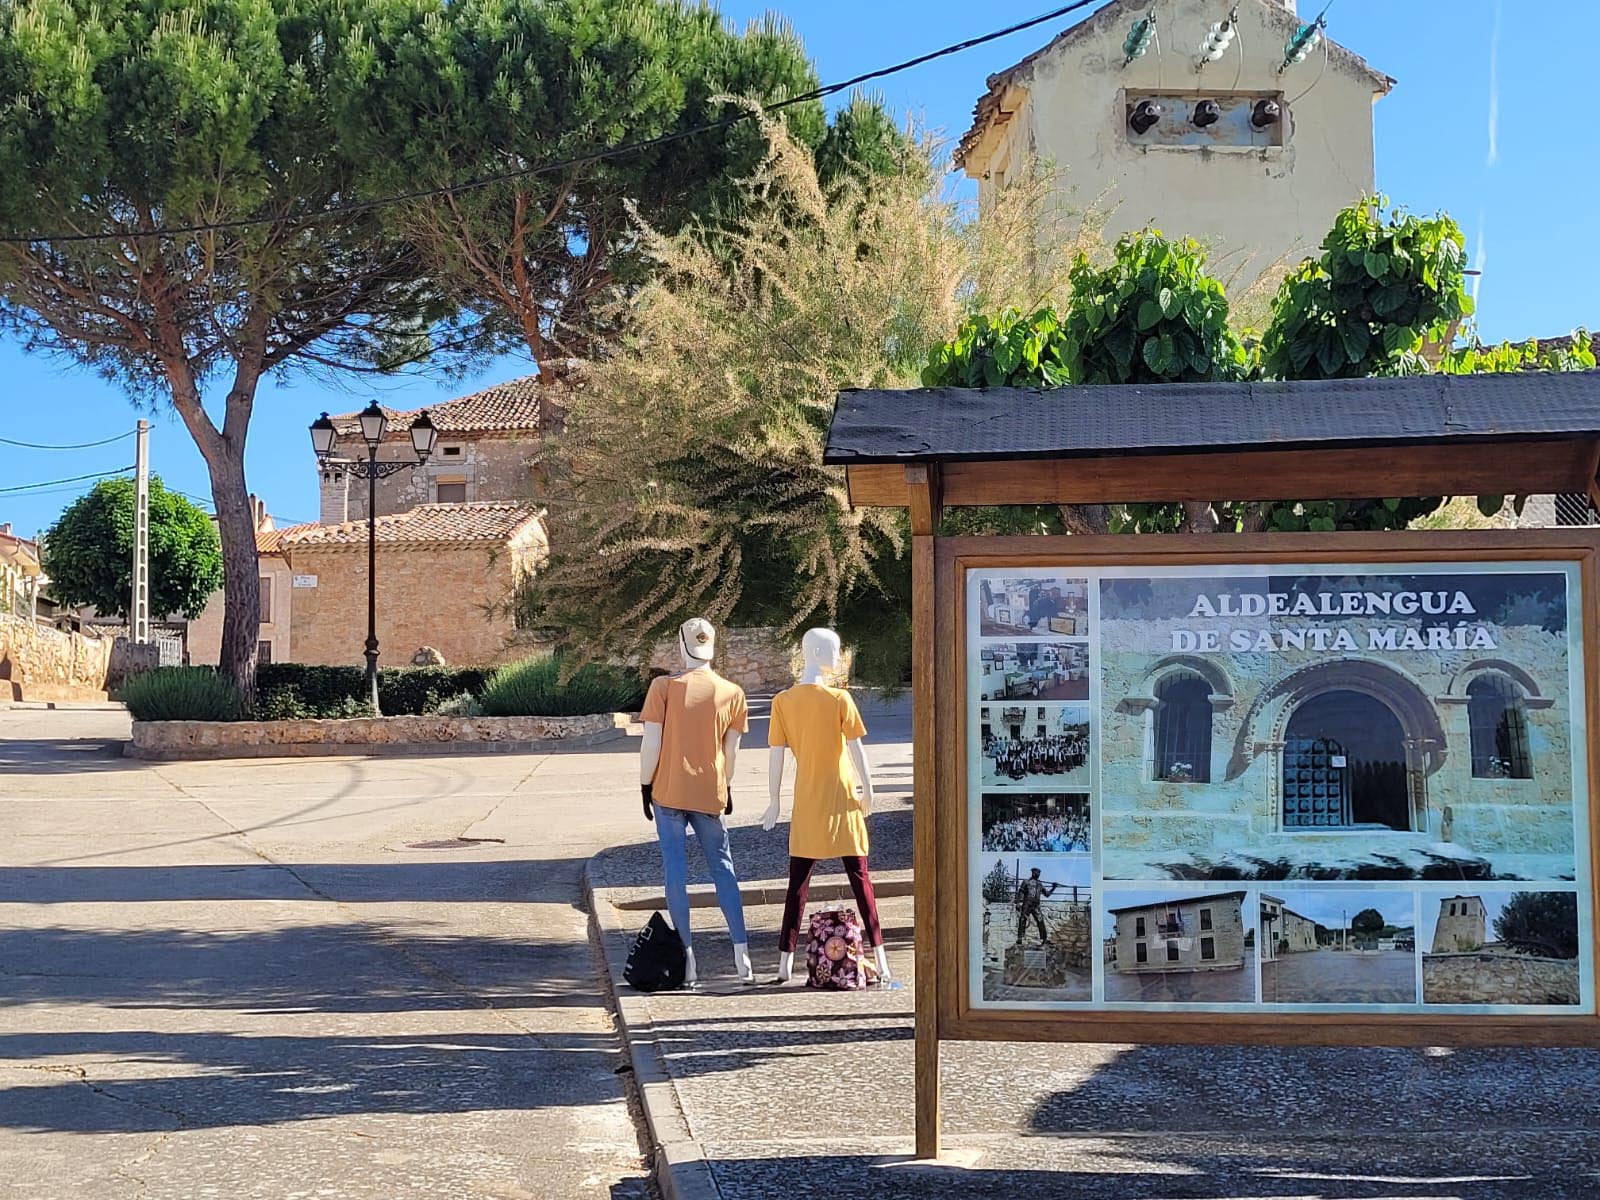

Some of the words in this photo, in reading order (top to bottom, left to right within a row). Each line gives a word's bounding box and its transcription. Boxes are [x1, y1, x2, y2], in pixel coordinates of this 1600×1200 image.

[1190, 591, 1476, 617] ALDEALENGUA
[1172, 630, 1220, 652] DE
[1230, 629, 1358, 651] SANTA
[1368, 623, 1498, 651] MARÍA
